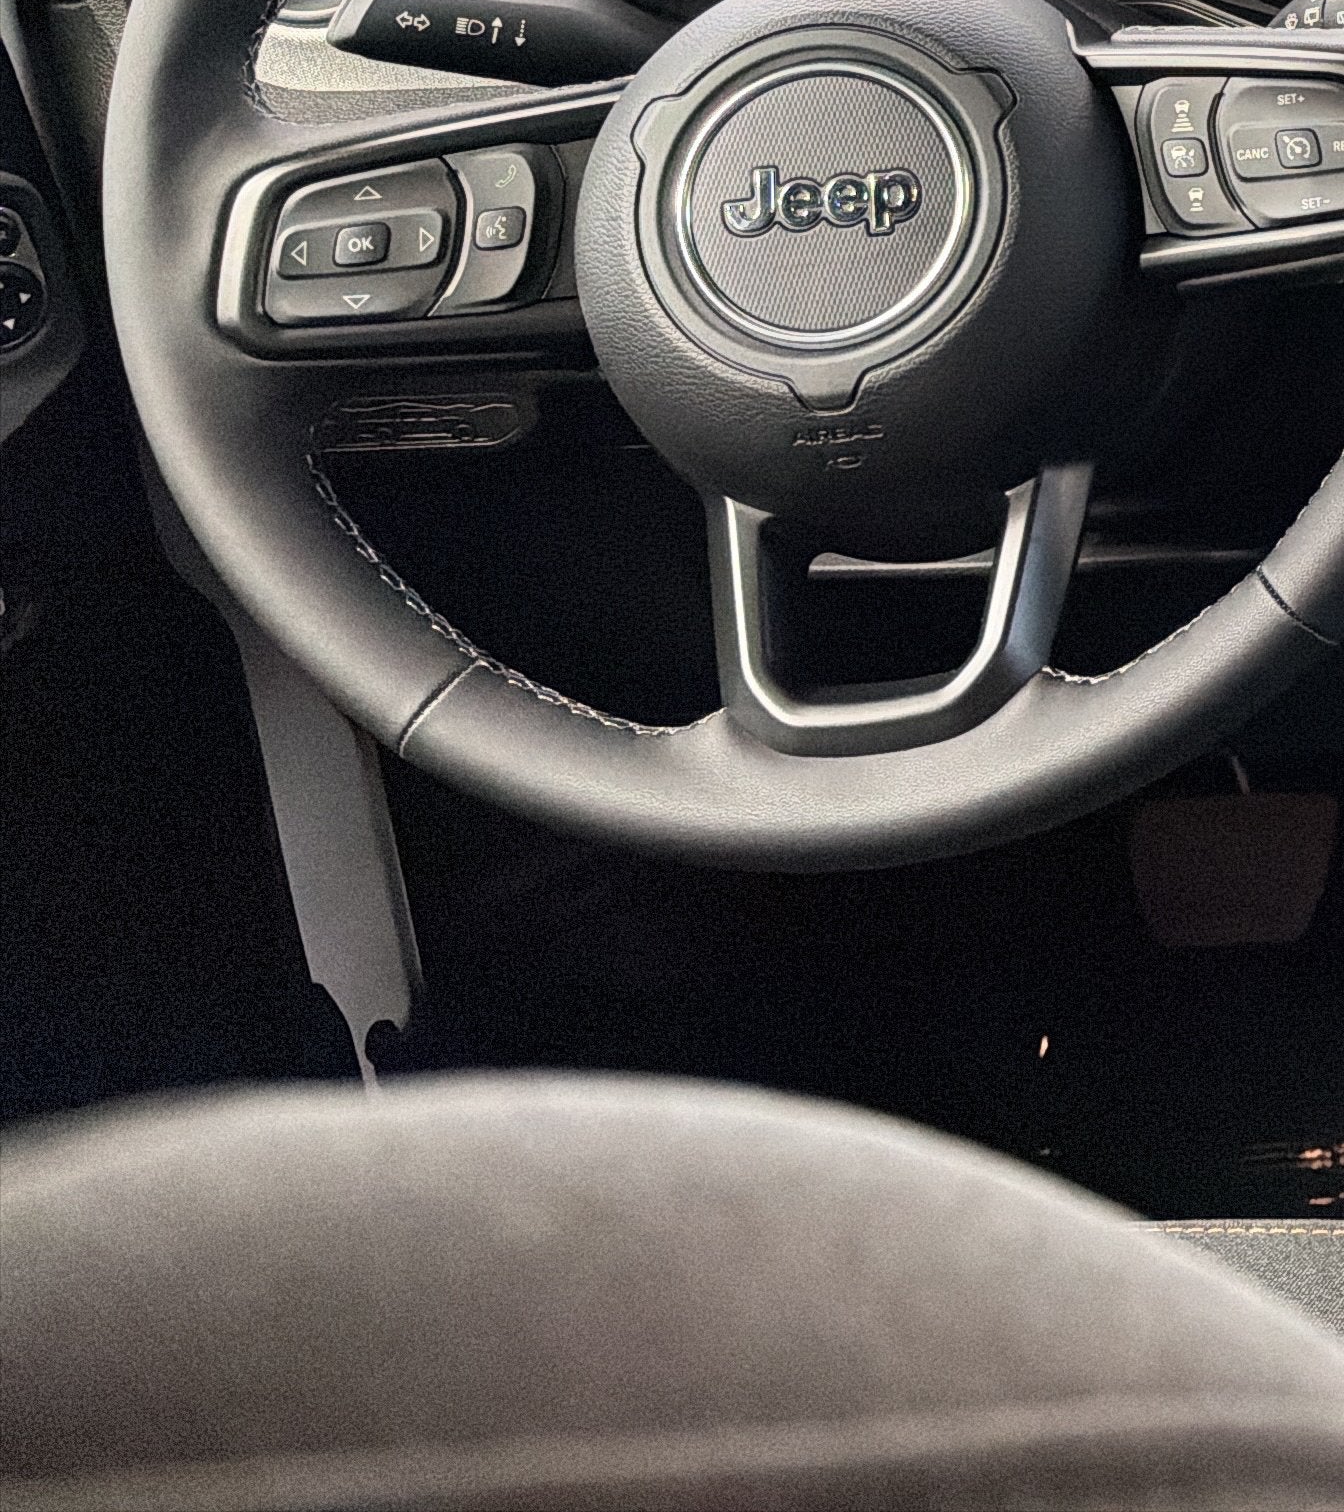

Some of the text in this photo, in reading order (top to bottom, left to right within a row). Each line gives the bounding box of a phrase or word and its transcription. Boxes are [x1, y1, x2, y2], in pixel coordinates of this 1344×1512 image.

[1277, 93, 1305, 106] SET+
[1237, 148, 1269, 160] CANC
[721, 166, 922, 238] Jeep
[348, 236, 374, 252] OK
